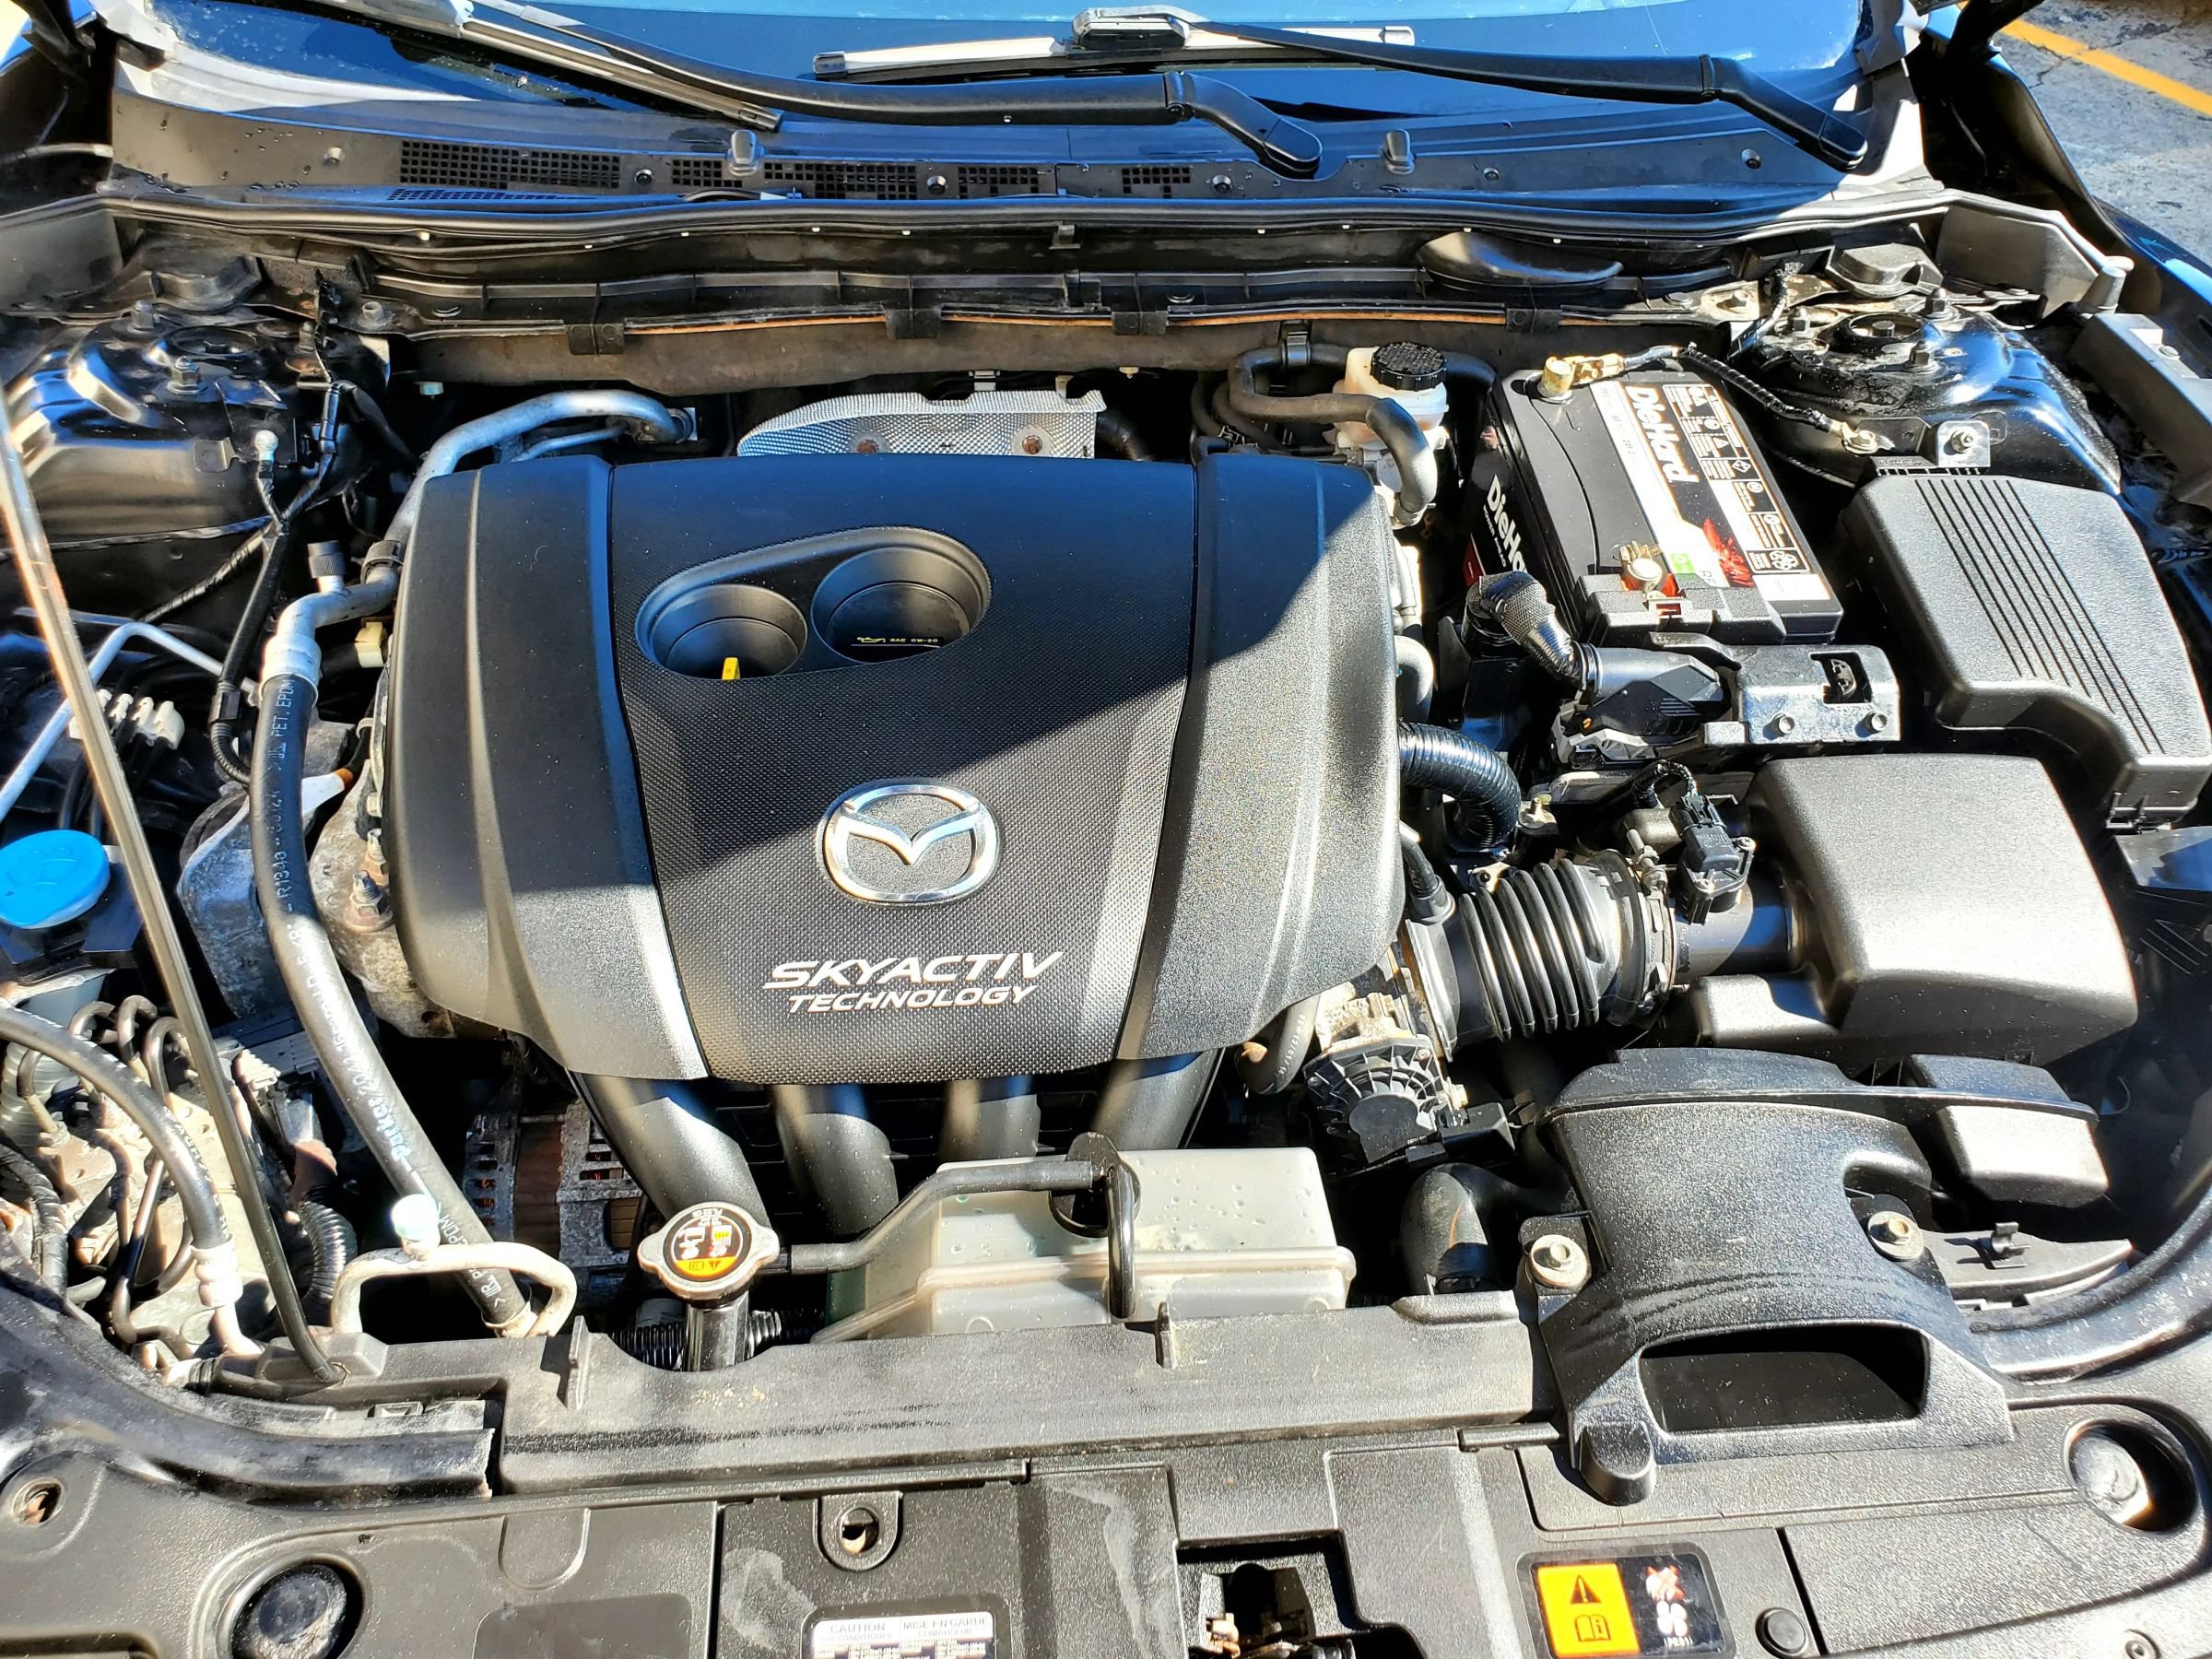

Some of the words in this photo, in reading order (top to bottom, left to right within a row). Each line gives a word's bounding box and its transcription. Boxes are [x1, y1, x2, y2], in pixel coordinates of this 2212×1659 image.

[1488, 476, 1529, 572] DieHa
[762, 951, 1064, 990] SKYACTIV
[788, 985, 1040, 1014] TECHNOLOGY
[830, 1622, 886, 1633] CAUTION
